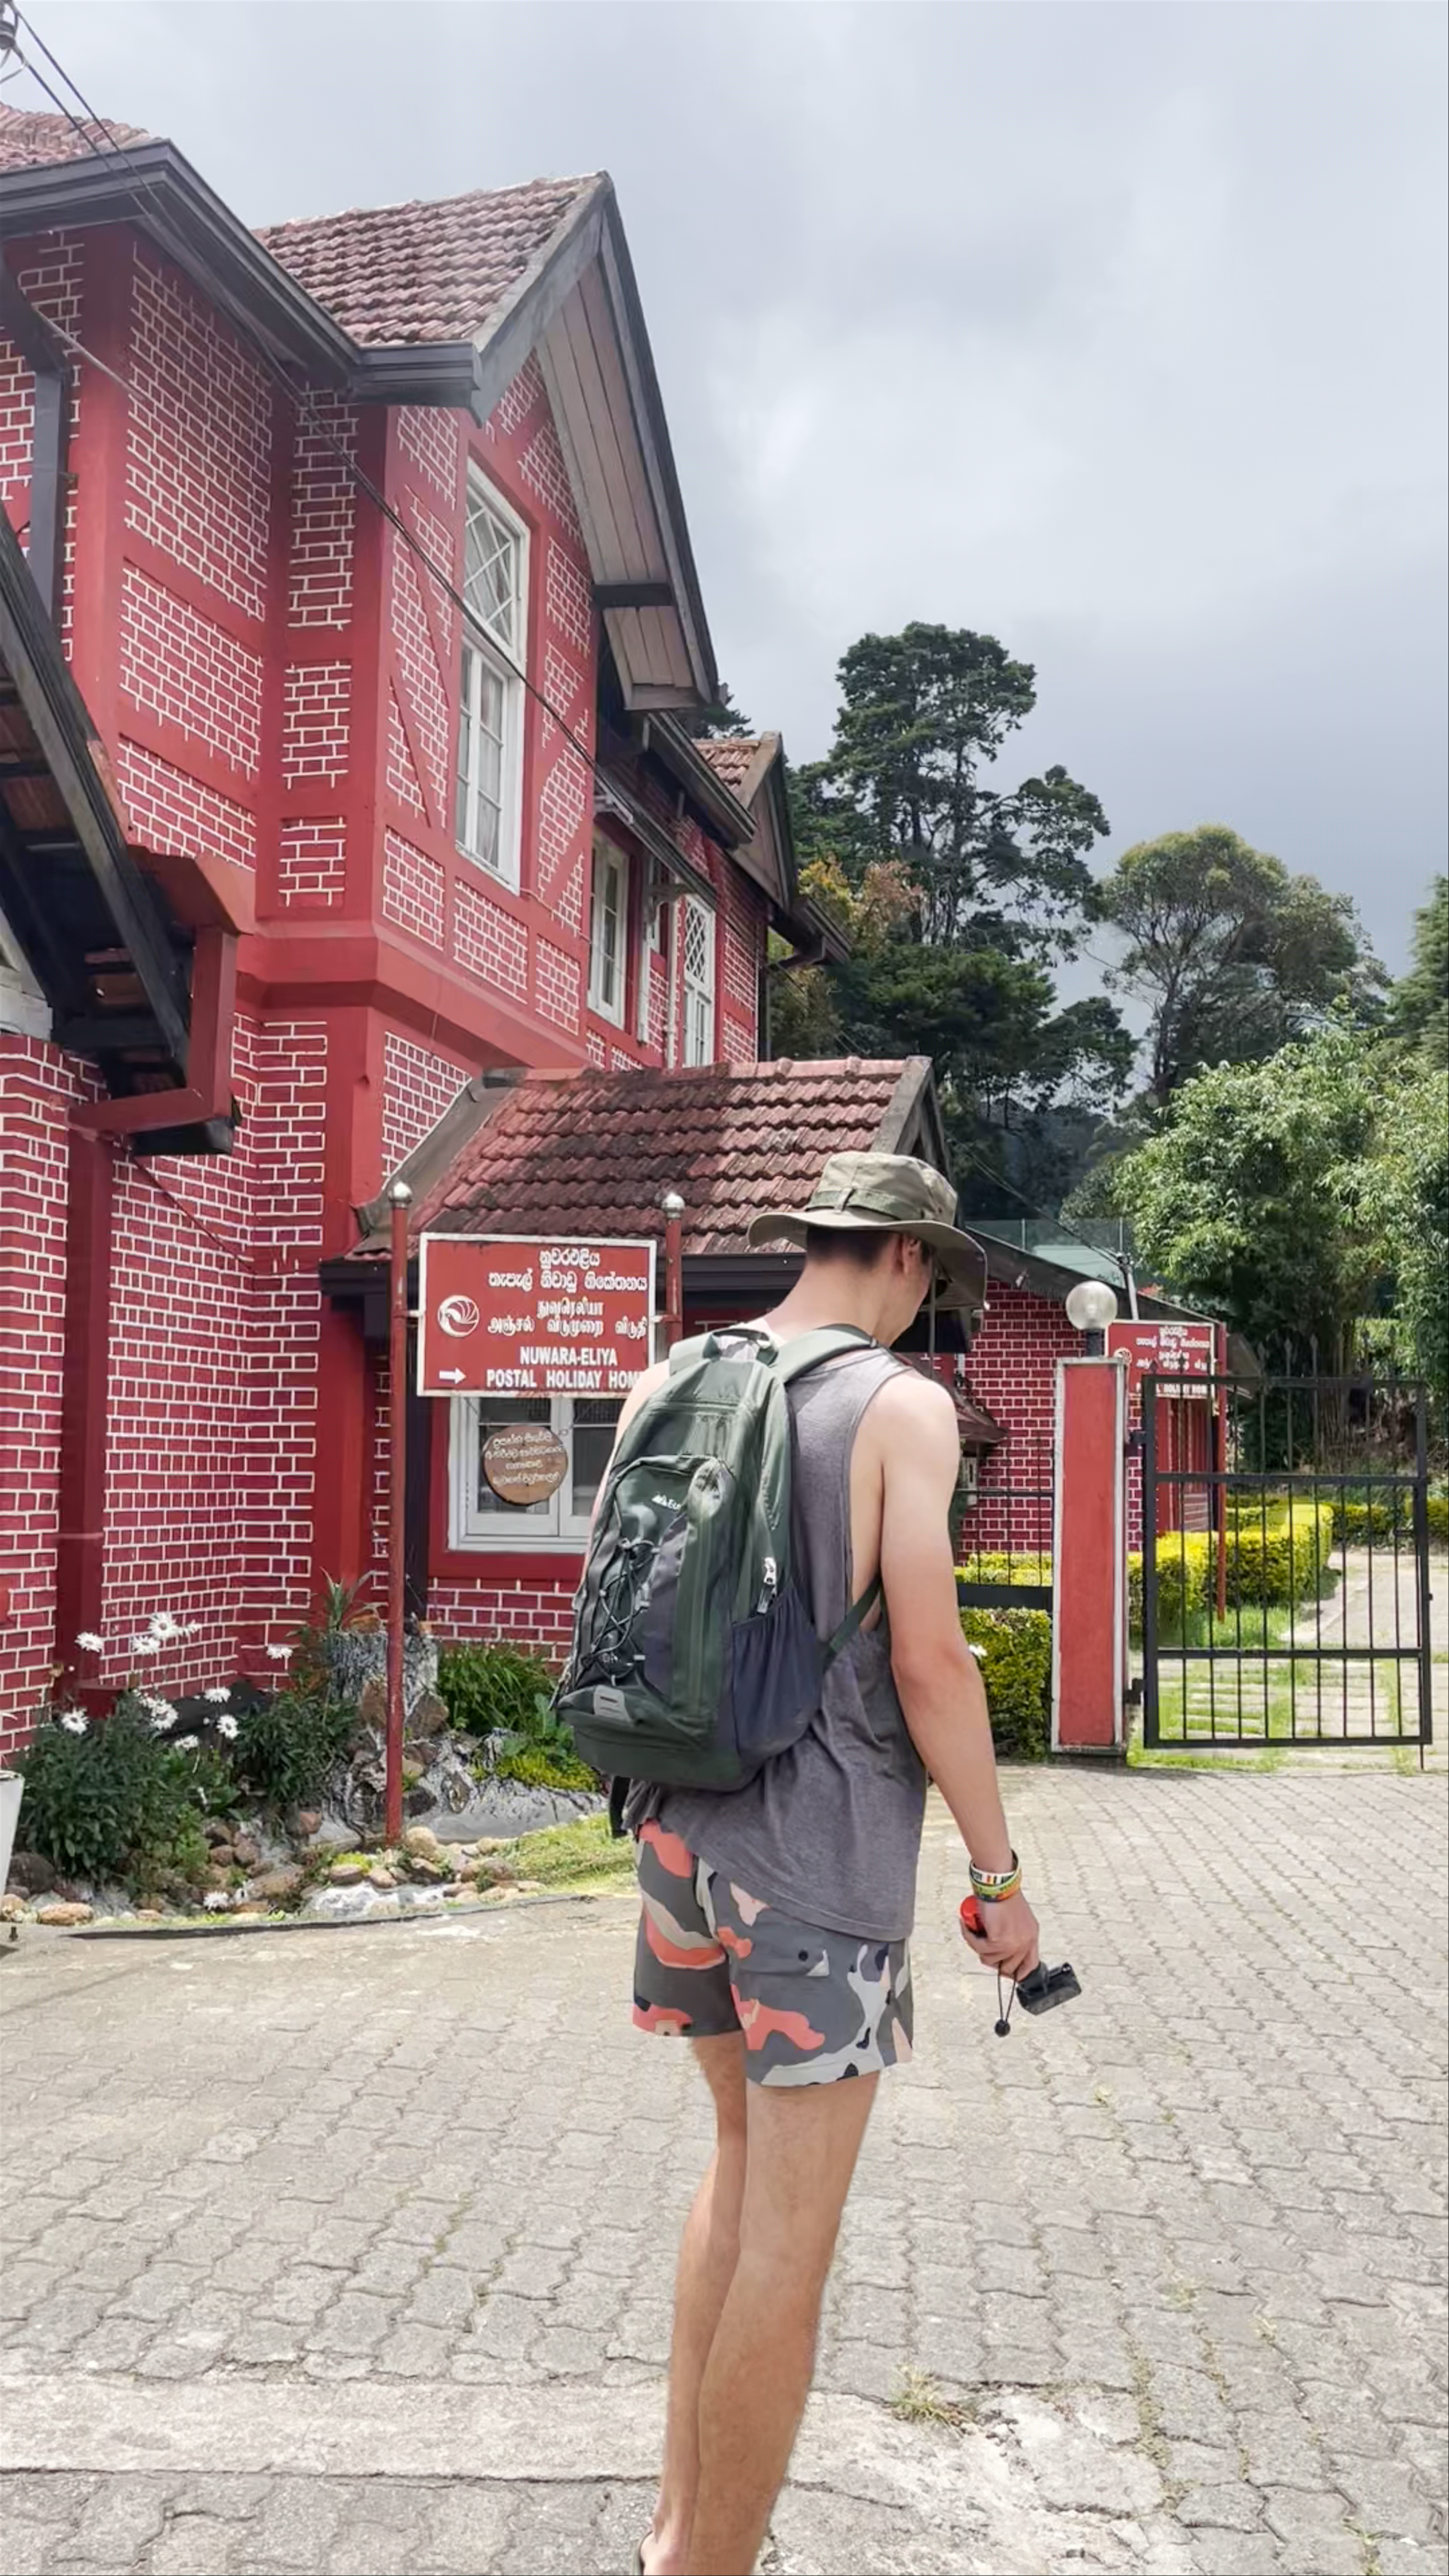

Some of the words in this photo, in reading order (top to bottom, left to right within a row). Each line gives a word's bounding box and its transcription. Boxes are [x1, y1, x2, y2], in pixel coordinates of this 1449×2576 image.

[520, 1346, 618, 1366] NUWARA-ELIYA
[486, 1369, 537, 1388] POSTAL
[546, 1370, 603, 1389] HOLIDAY
[608, 1370, 641, 1389] HOM
